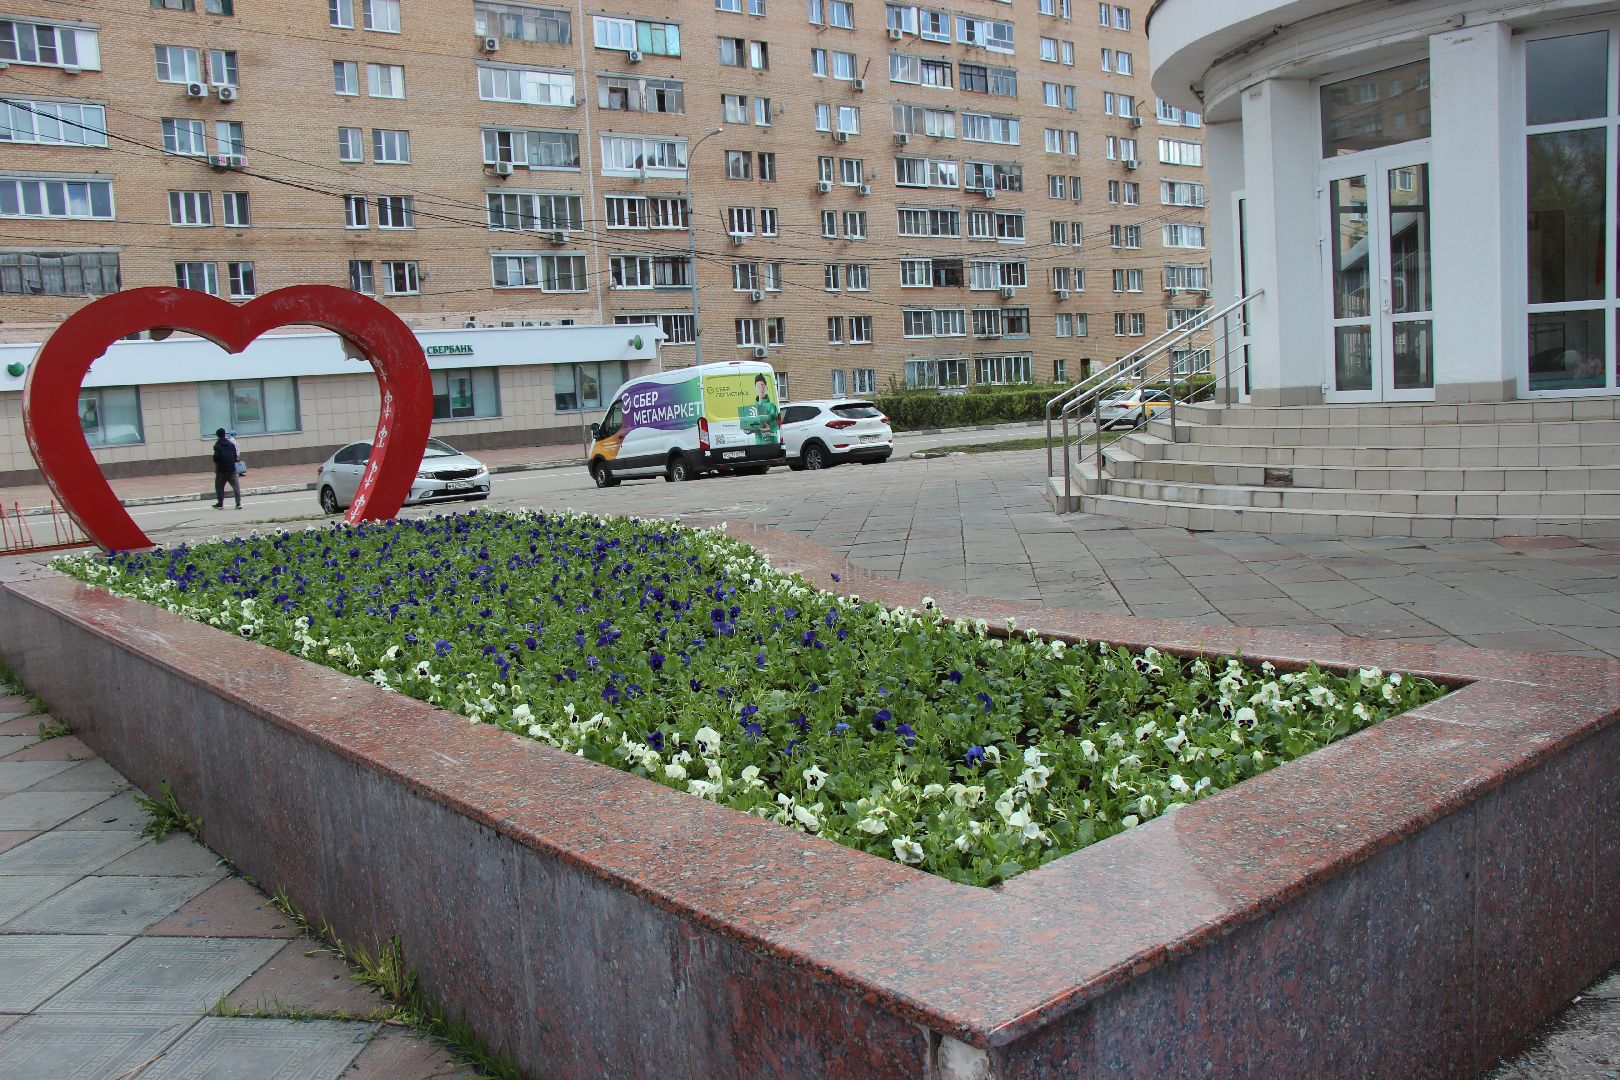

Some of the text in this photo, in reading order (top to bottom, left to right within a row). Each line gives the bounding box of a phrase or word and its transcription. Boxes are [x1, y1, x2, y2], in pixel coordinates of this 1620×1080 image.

[426, 345, 474, 354] СБЕРБАНК
[633, 391, 659, 408] СБЕР
[633, 401, 703, 426] МЕГАМАРКЕТ
